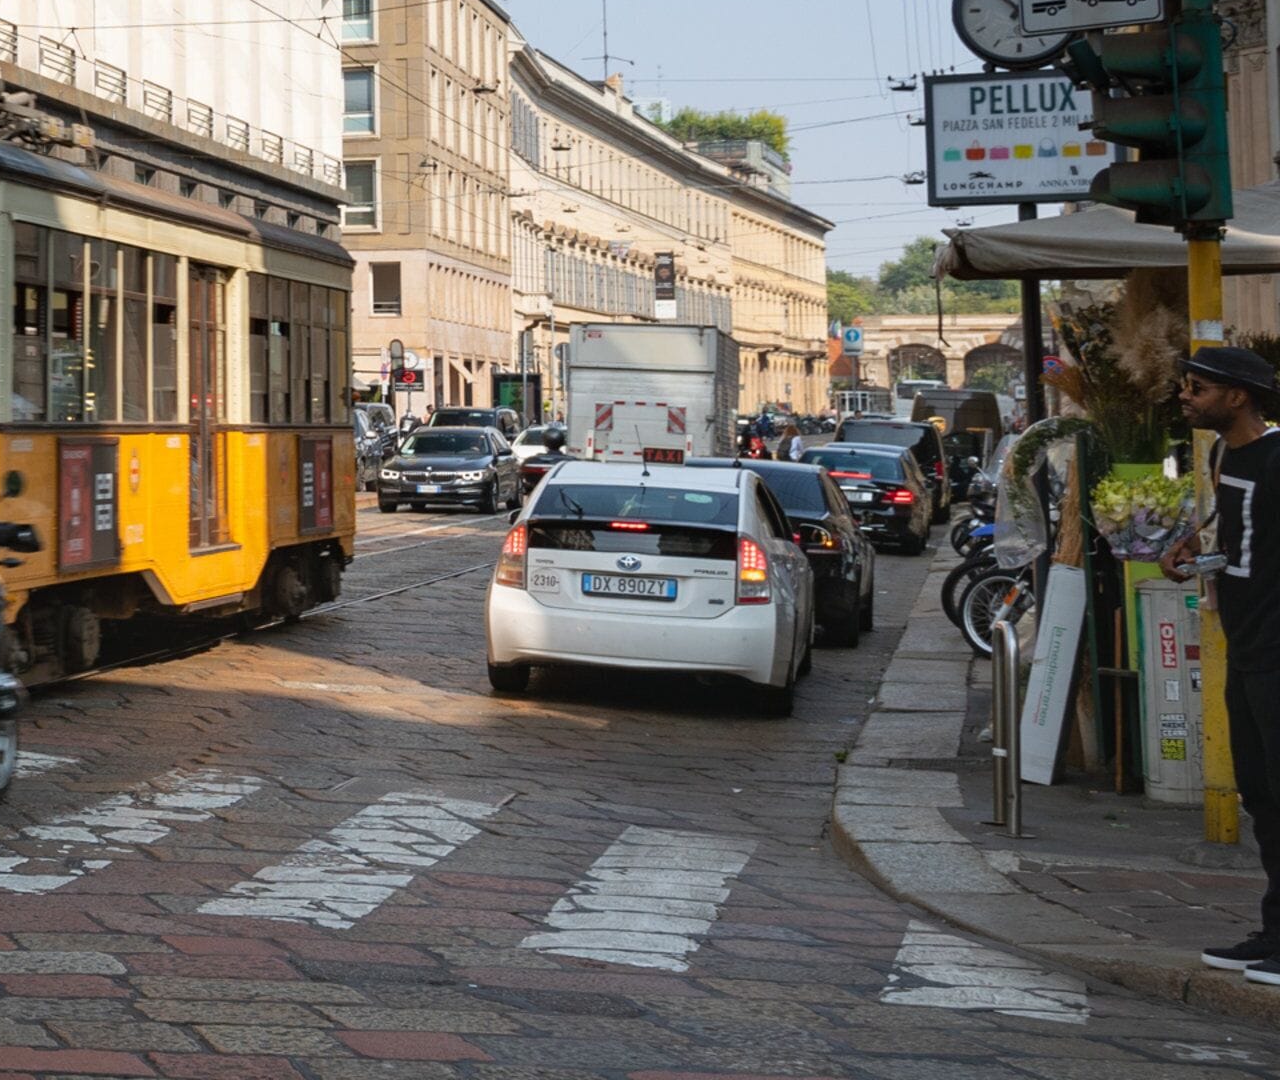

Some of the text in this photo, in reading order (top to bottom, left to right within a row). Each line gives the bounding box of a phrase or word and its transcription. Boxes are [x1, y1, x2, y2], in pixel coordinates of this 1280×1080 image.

[969, 82, 1077, 116] PELLUX
[942, 119, 979, 132] PIAZZA
[982, 117, 1004, 130] SAN
[1007, 116, 1046, 129] FEDELE
[1051, 115, 1058, 128] 2
[942, 181, 1024, 191] LONGCHAMP
[645, 449, 683, 462] TAXI
[592, 575, 666, 596] DX 890ZY
